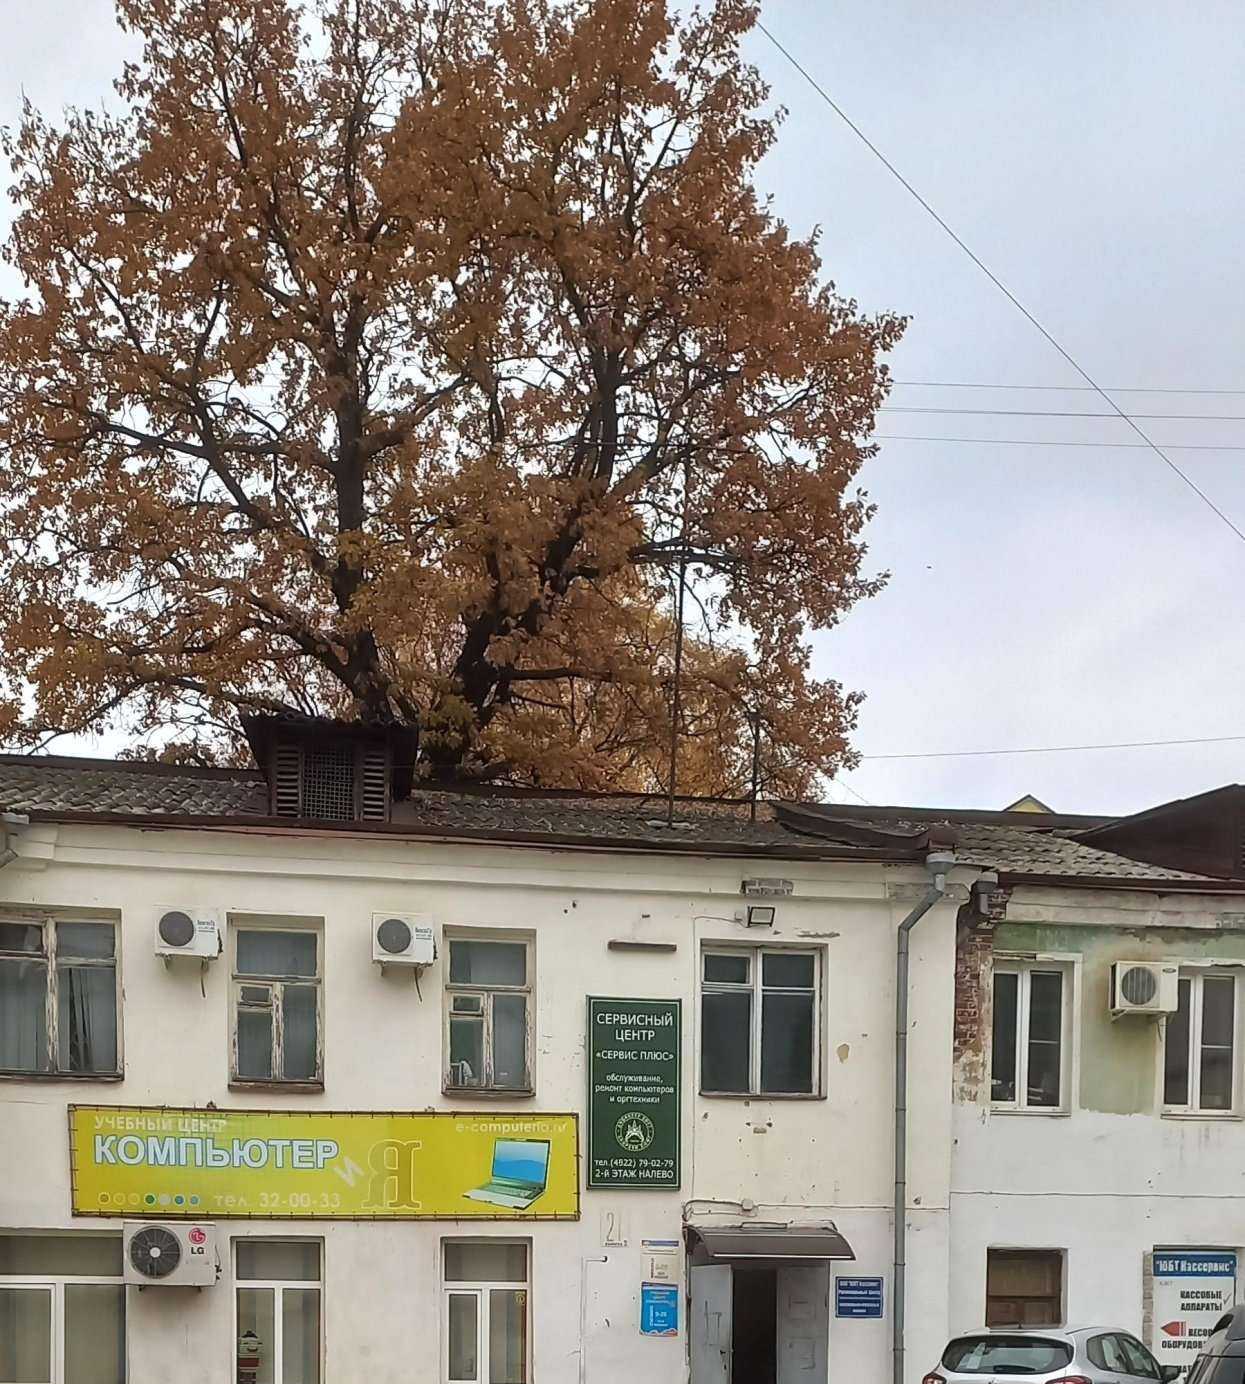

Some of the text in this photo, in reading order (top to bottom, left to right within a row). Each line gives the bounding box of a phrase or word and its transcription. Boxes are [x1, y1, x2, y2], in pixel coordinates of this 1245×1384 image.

[597, 1012, 673, 1026] СЕРВИСНЫЙ
[615, 1029, 655, 1042] ЦЕНТР
[596, 1050, 674, 1060] «СЕРВИС ПЛЮС»
[606, 1073, 663, 1083] обслуживание,
[595, 1085, 674, 1094] ремонт компьютеров
[616, 1096, 660, 1104] оргтехники
[95, 1115, 172, 1131] УЧЕБНЫЙ
[95, 1134, 339, 1169] КОМПЬЮТЕР
[639, 1159, 674, 1168] 79-02-79
[611, 1169, 637, 1178] ЭТАЖ
[638, 1169, 674, 1179] НАЛЕВО
[259, 1192, 342, 1208] 32-00-33
[191, 1246, 205, 1255] LG
[1180, 1290, 1222, 1299] КАССОВЫЕ
[1181, 1302, 1222, 1311] АППАРАТЫ
[1161, 1340, 1206, 1350] ОБОРУДОВ
